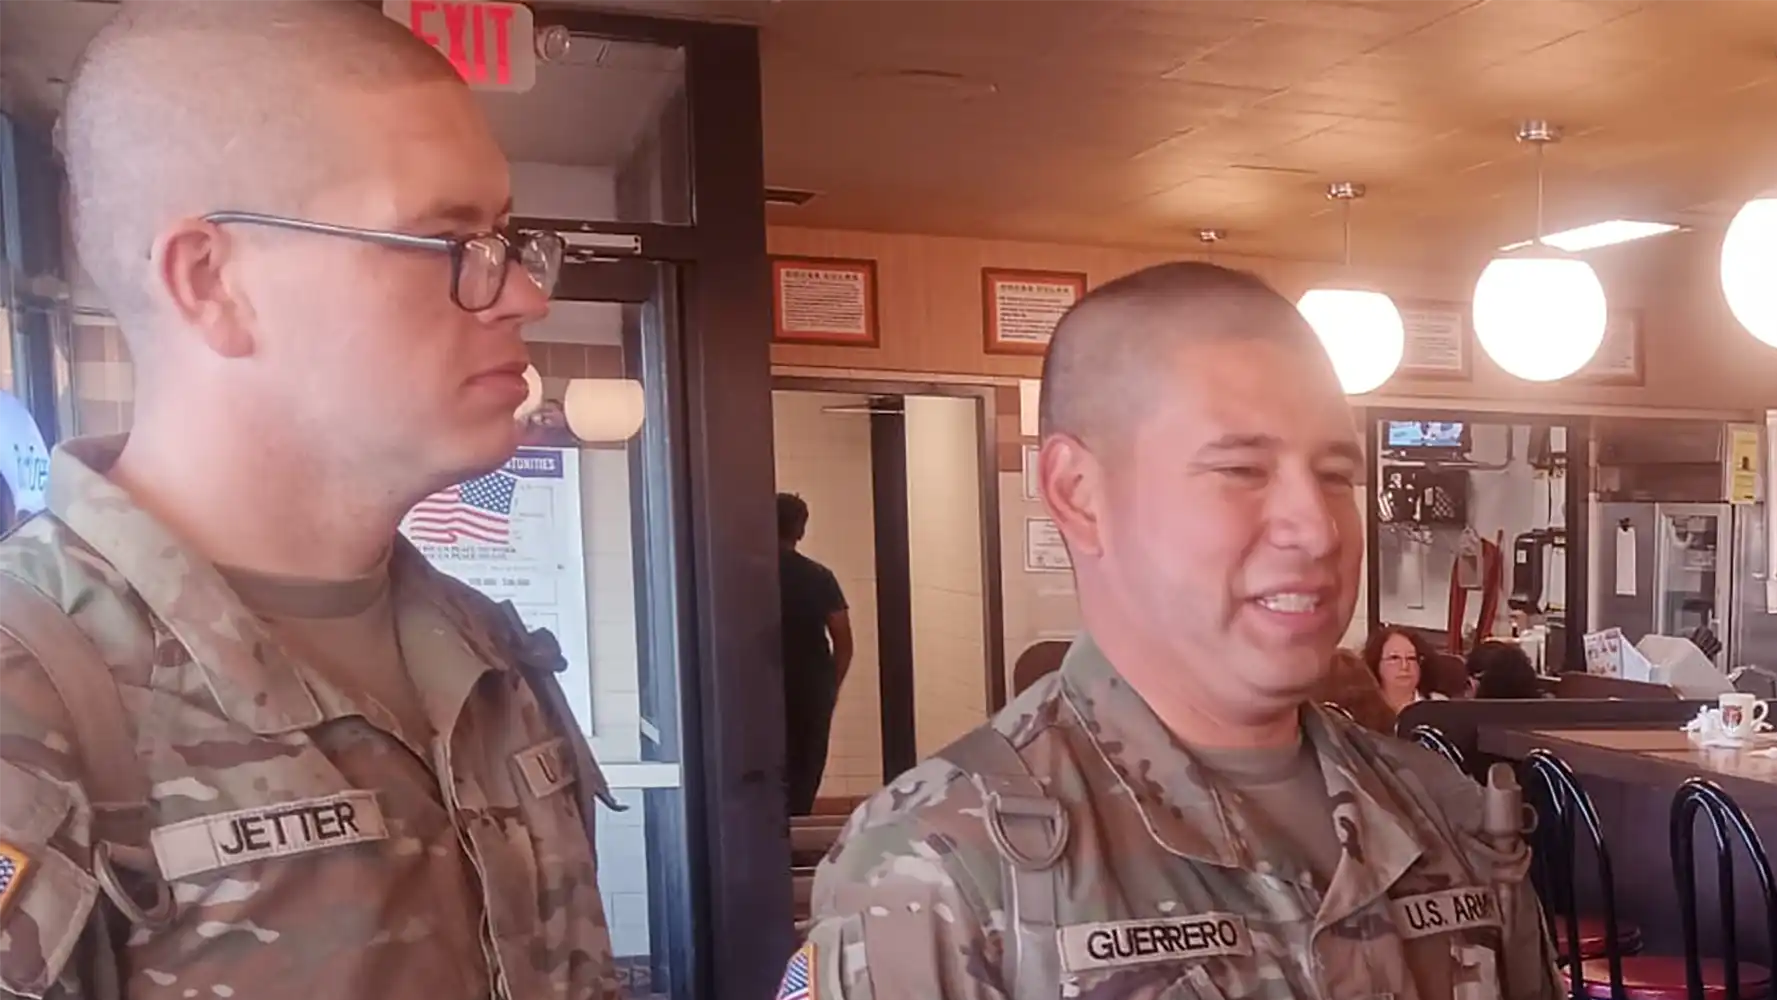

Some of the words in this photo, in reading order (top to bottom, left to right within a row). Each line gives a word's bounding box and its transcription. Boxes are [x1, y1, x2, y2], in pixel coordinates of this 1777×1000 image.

[410, 0, 514, 85] EXIT
[220, 801, 359, 854] JETTER
[1404, 899, 1447, 930] U.S.
[1087, 919, 1237, 960] GUERRERO
